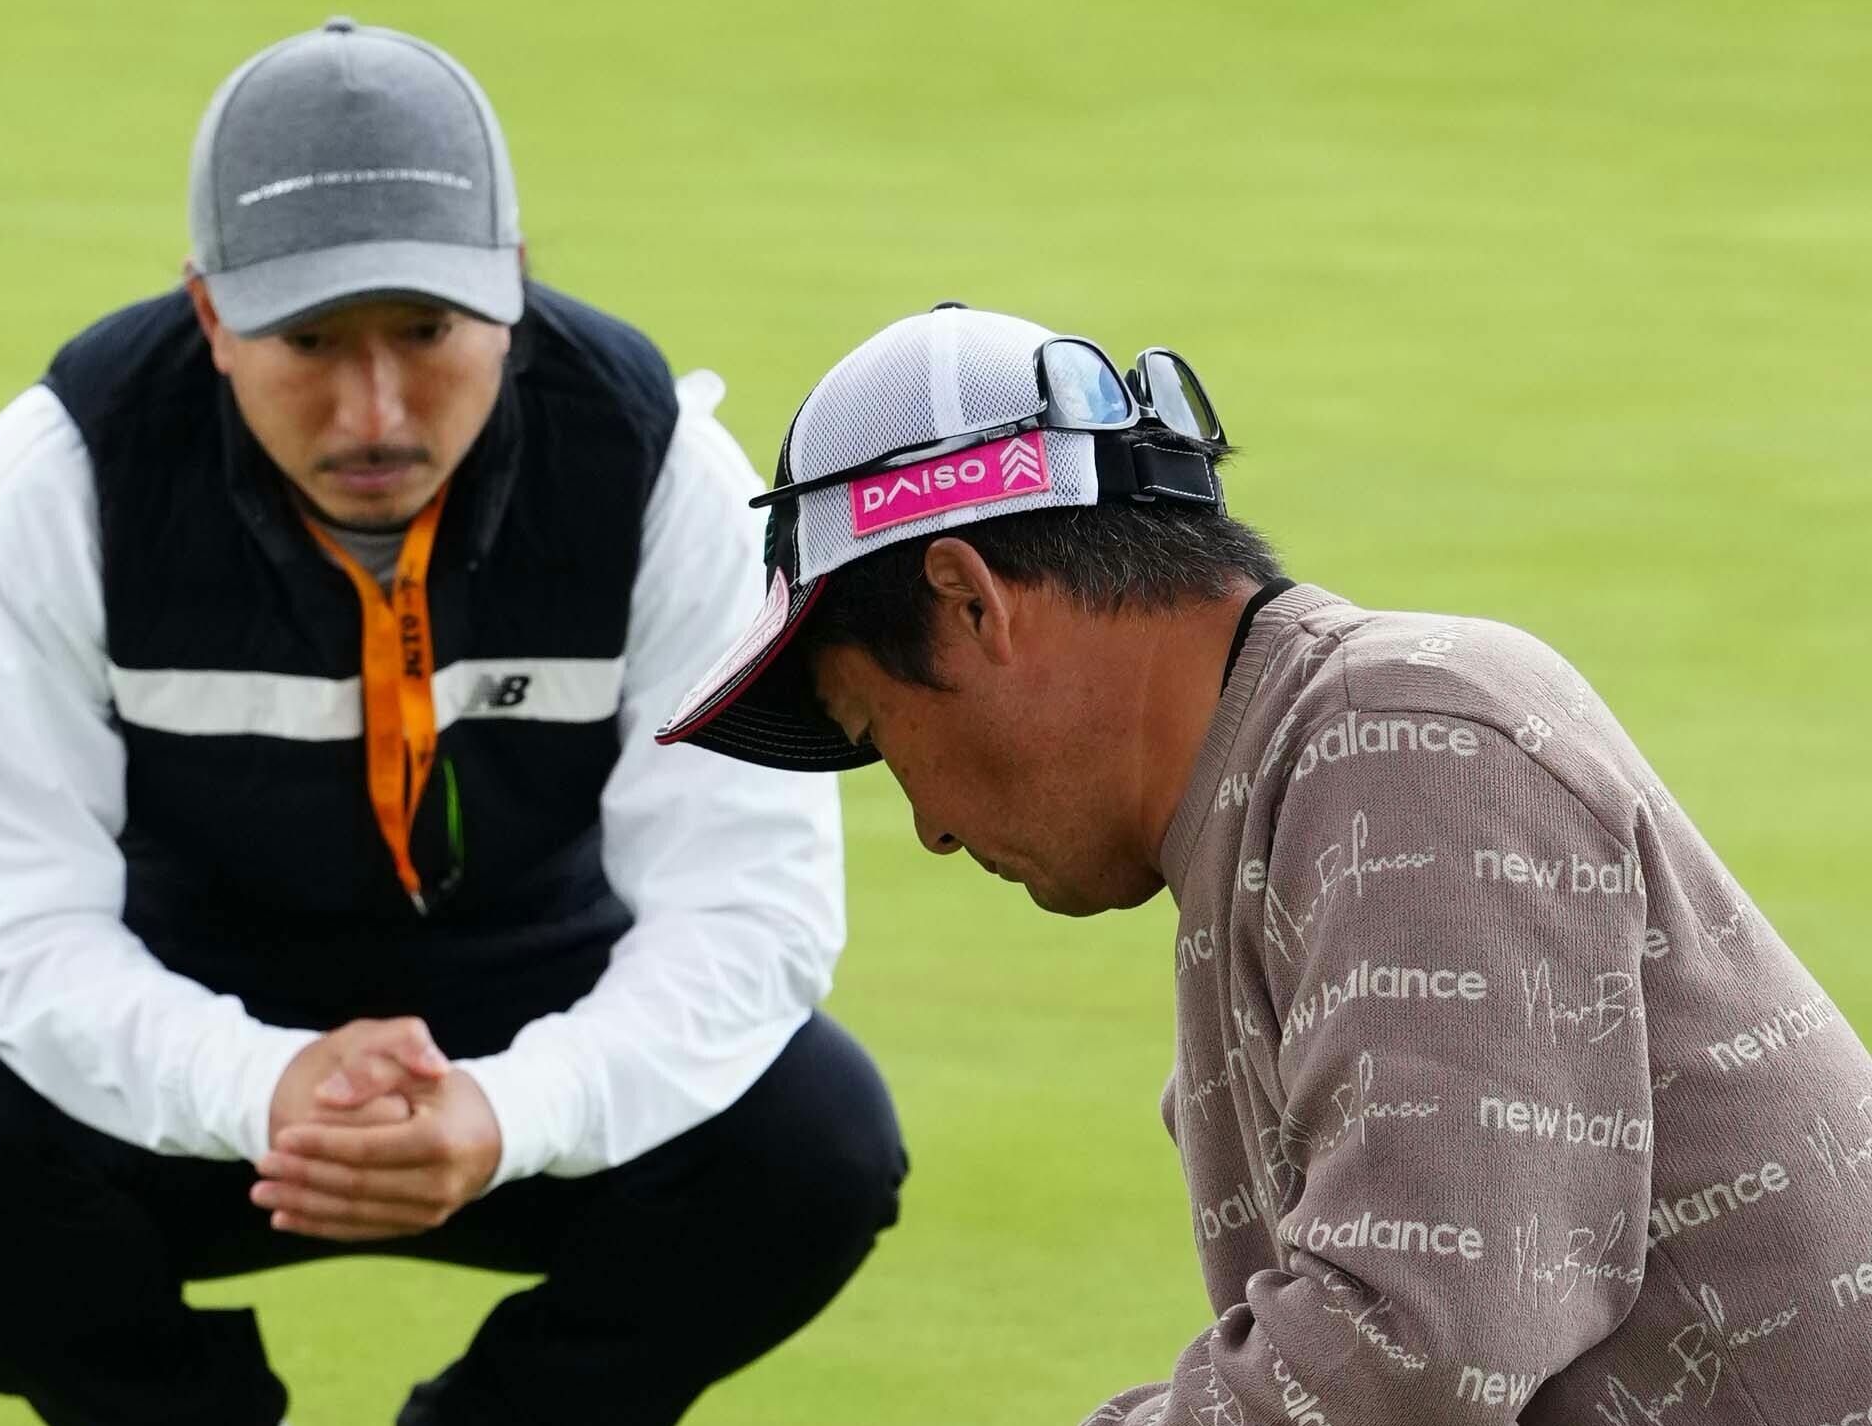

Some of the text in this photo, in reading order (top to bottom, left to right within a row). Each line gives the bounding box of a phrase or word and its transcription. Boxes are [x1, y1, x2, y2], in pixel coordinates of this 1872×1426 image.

[863, 458, 986, 514] DAISO
[1474, 847, 1561, 890] new
[1320, 959, 1488, 1020] balance
[1479, 1094, 1561, 1142] new
[1306, 1211, 1485, 1261] balance
